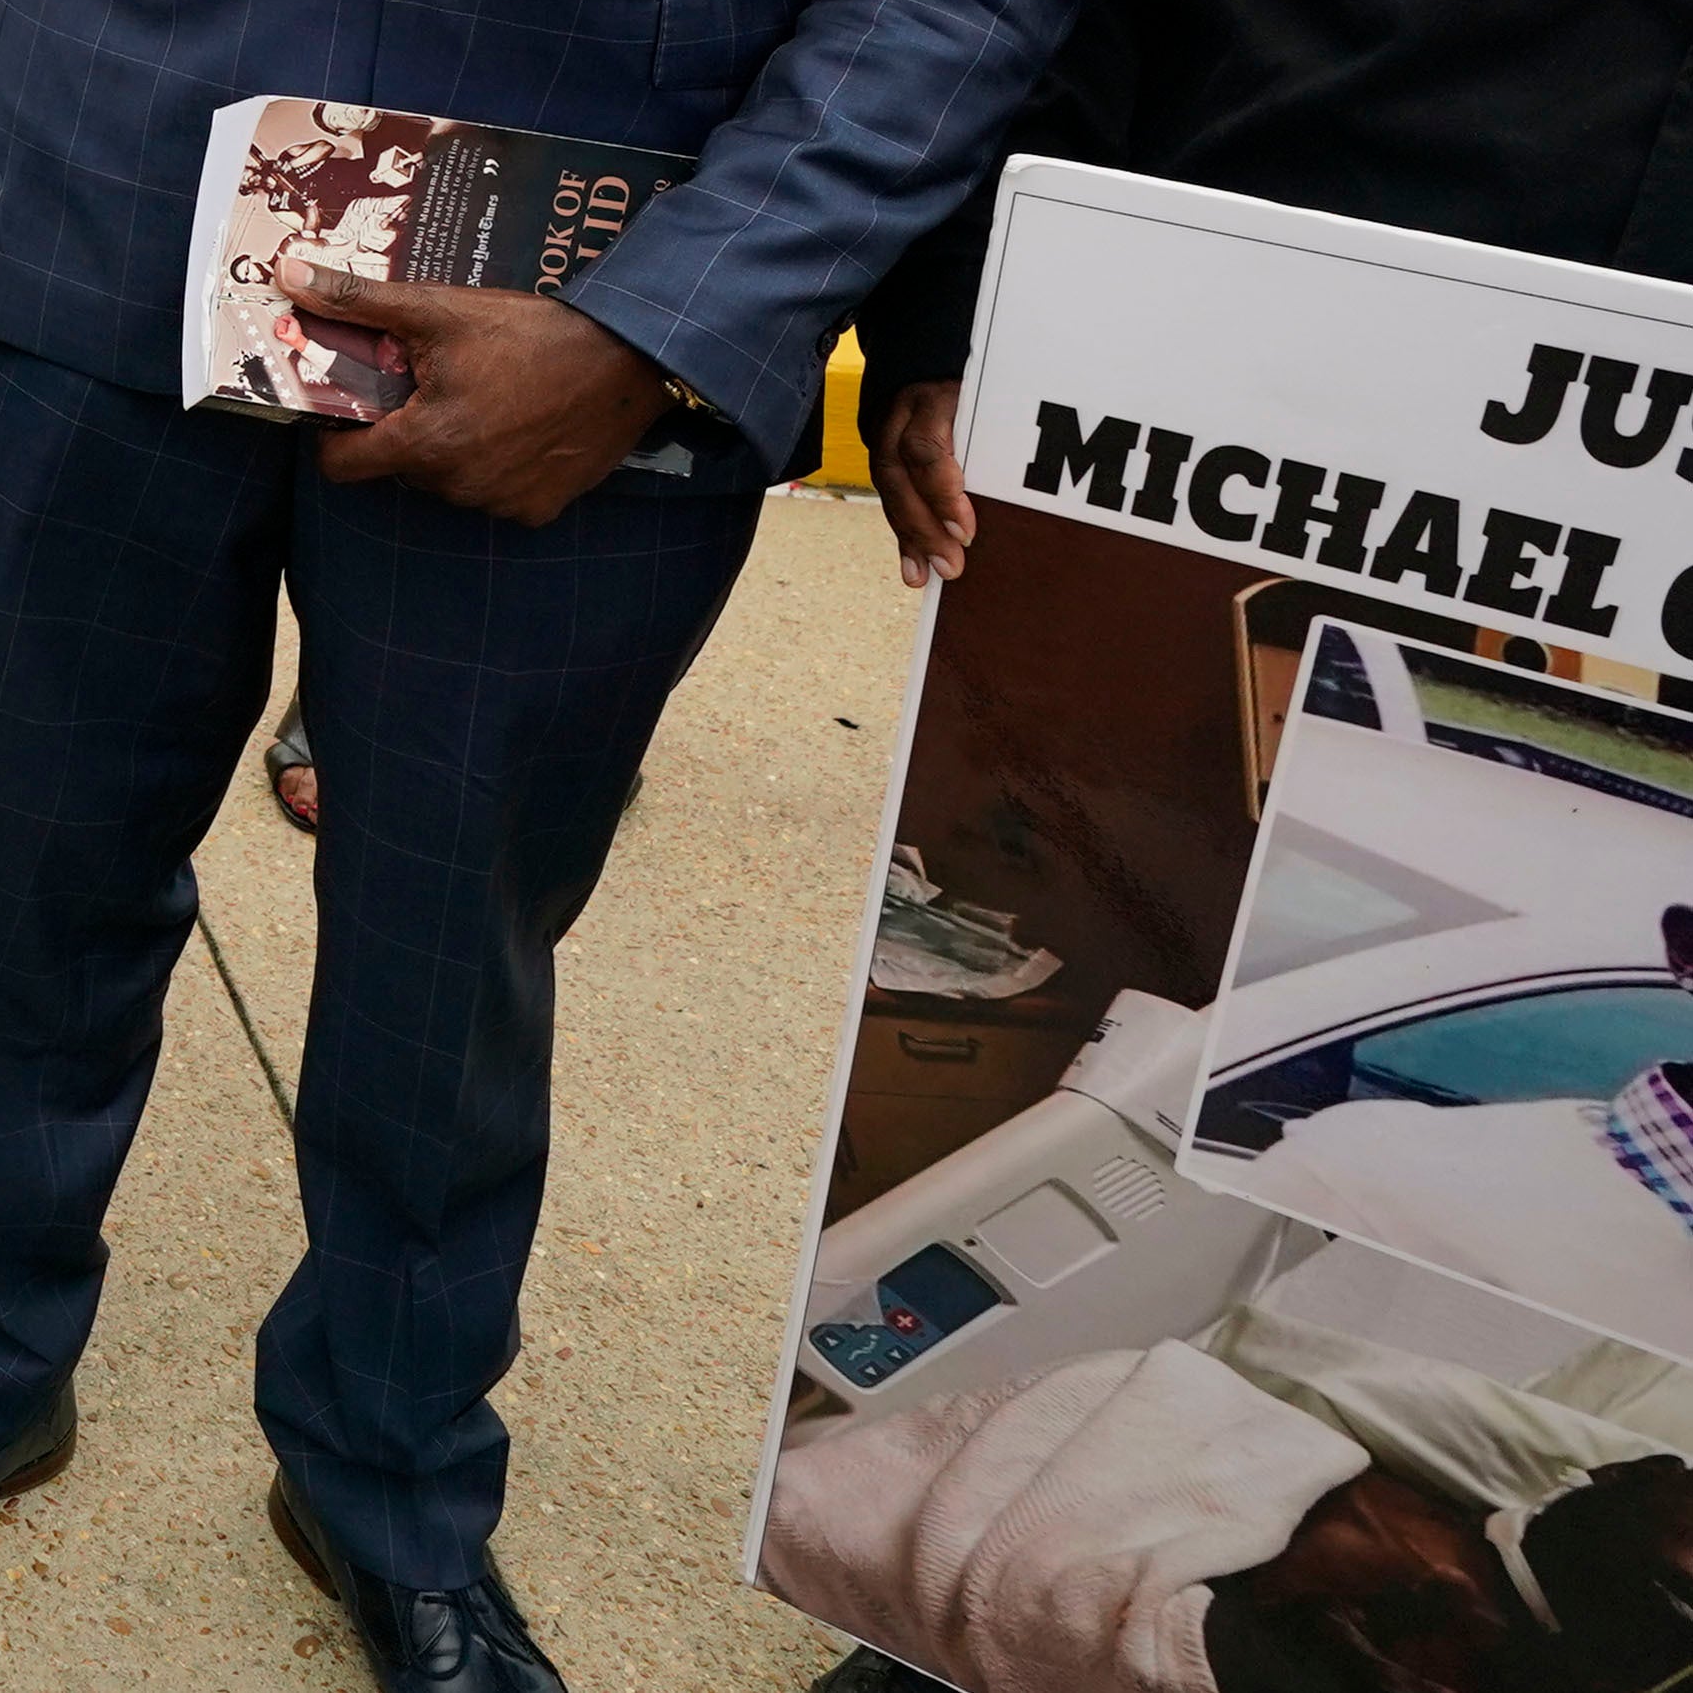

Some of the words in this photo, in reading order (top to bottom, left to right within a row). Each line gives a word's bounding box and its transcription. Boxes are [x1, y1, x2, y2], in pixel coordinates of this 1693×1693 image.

[420, 255, 431, 282] ader
[426, 241, 434, 253] of
[431, 219, 439, 240] the
[440, 138, 461, 193] generation
[434, 232, 449, 259] black
[442, 189, 457, 228] leaders
[453, 177, 461, 187] to
[459, 147, 470, 174] some
[449, 195, 470, 257] hatemonger
[463, 182, 472, 193] to
[478, 194, 500, 232] Times
[553, 169, 588, 217] OF
[411, 226, 426, 258] Abdul
[1022, 399, 1622, 639] MICHAEL
